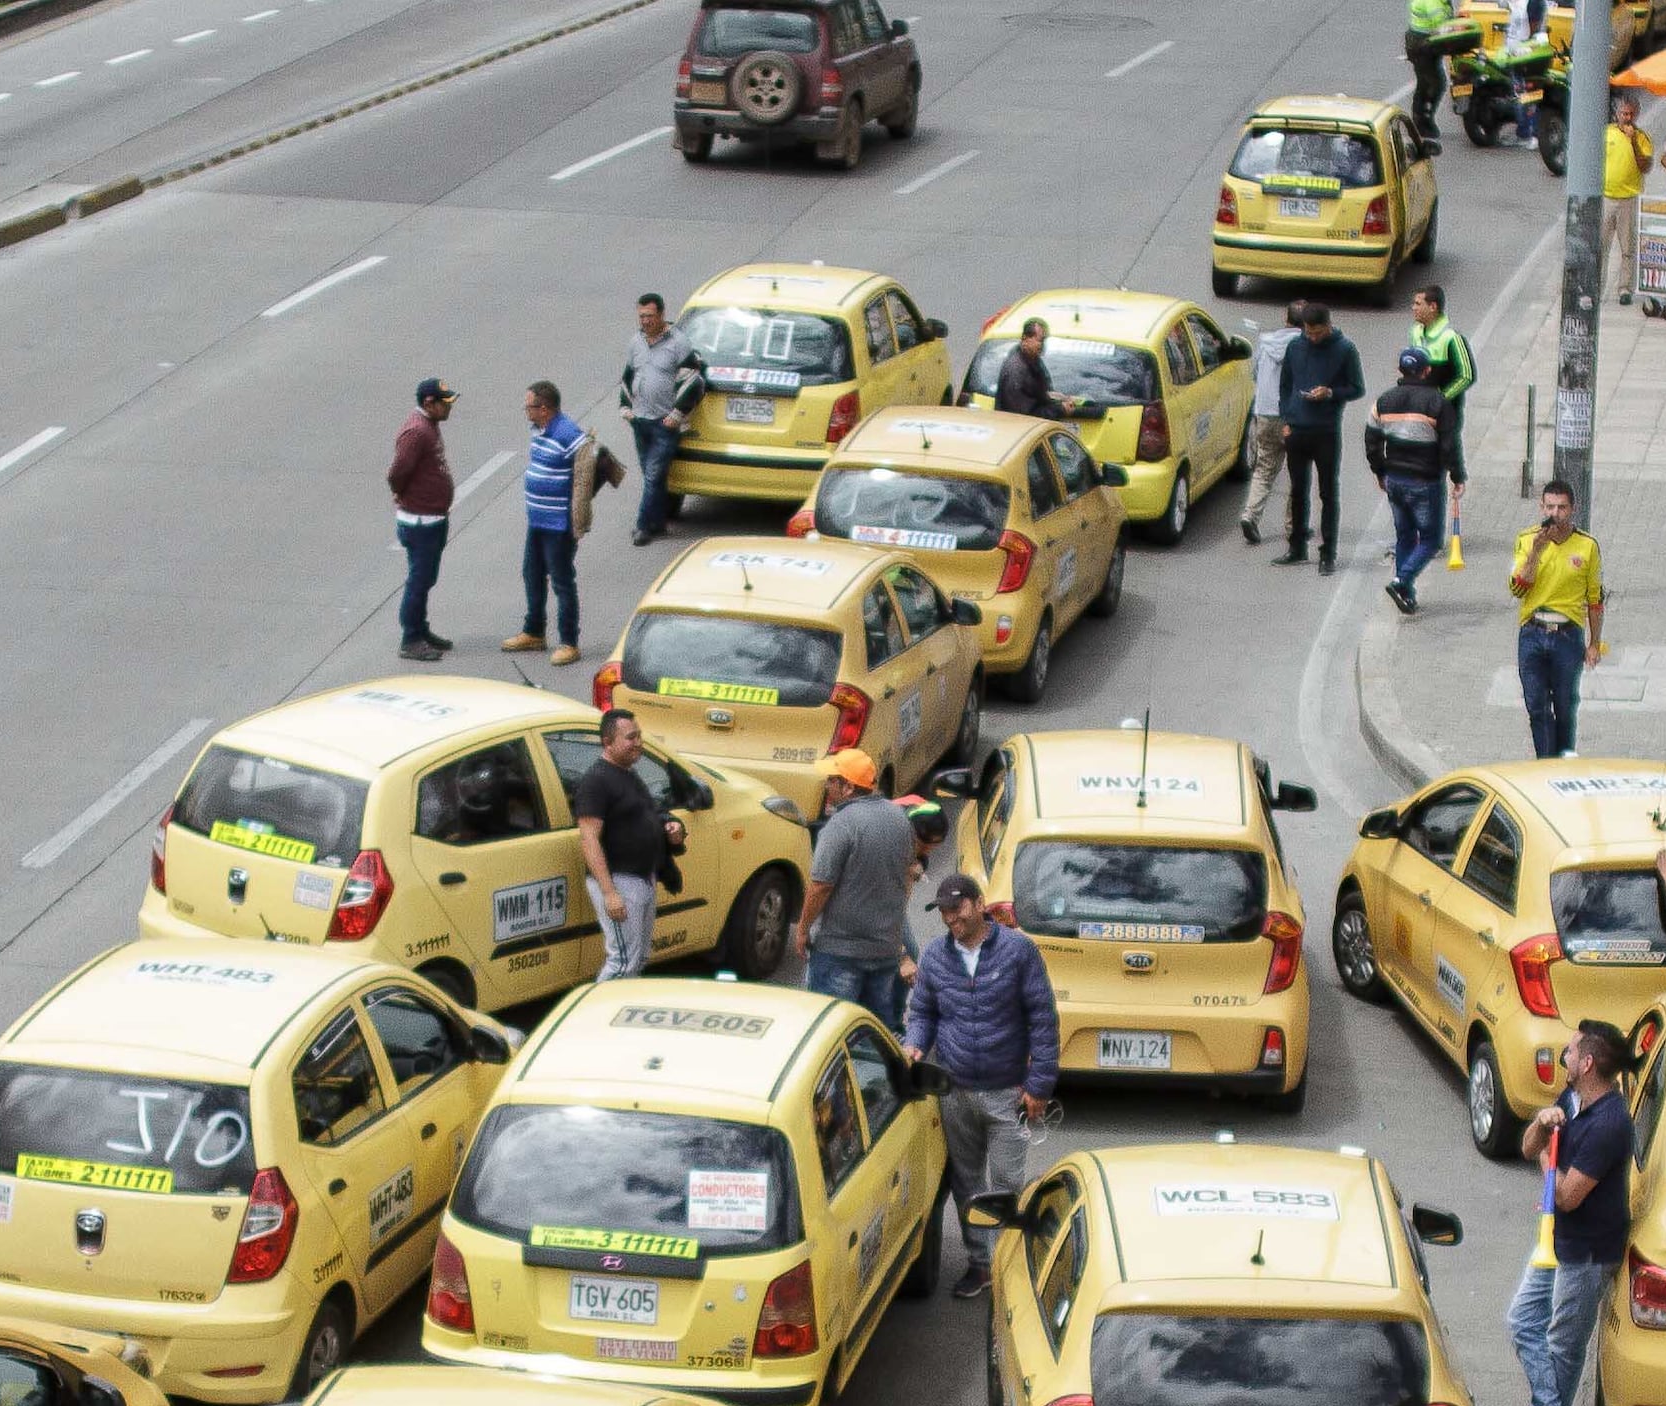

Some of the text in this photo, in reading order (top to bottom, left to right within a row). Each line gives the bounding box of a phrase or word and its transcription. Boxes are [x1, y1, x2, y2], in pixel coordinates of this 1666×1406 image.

[1102, 1039, 1169, 1060] WNV 124
[1161, 1190, 1331, 1207] WCL 583
[573, 1284, 656, 1314] TGV 605
